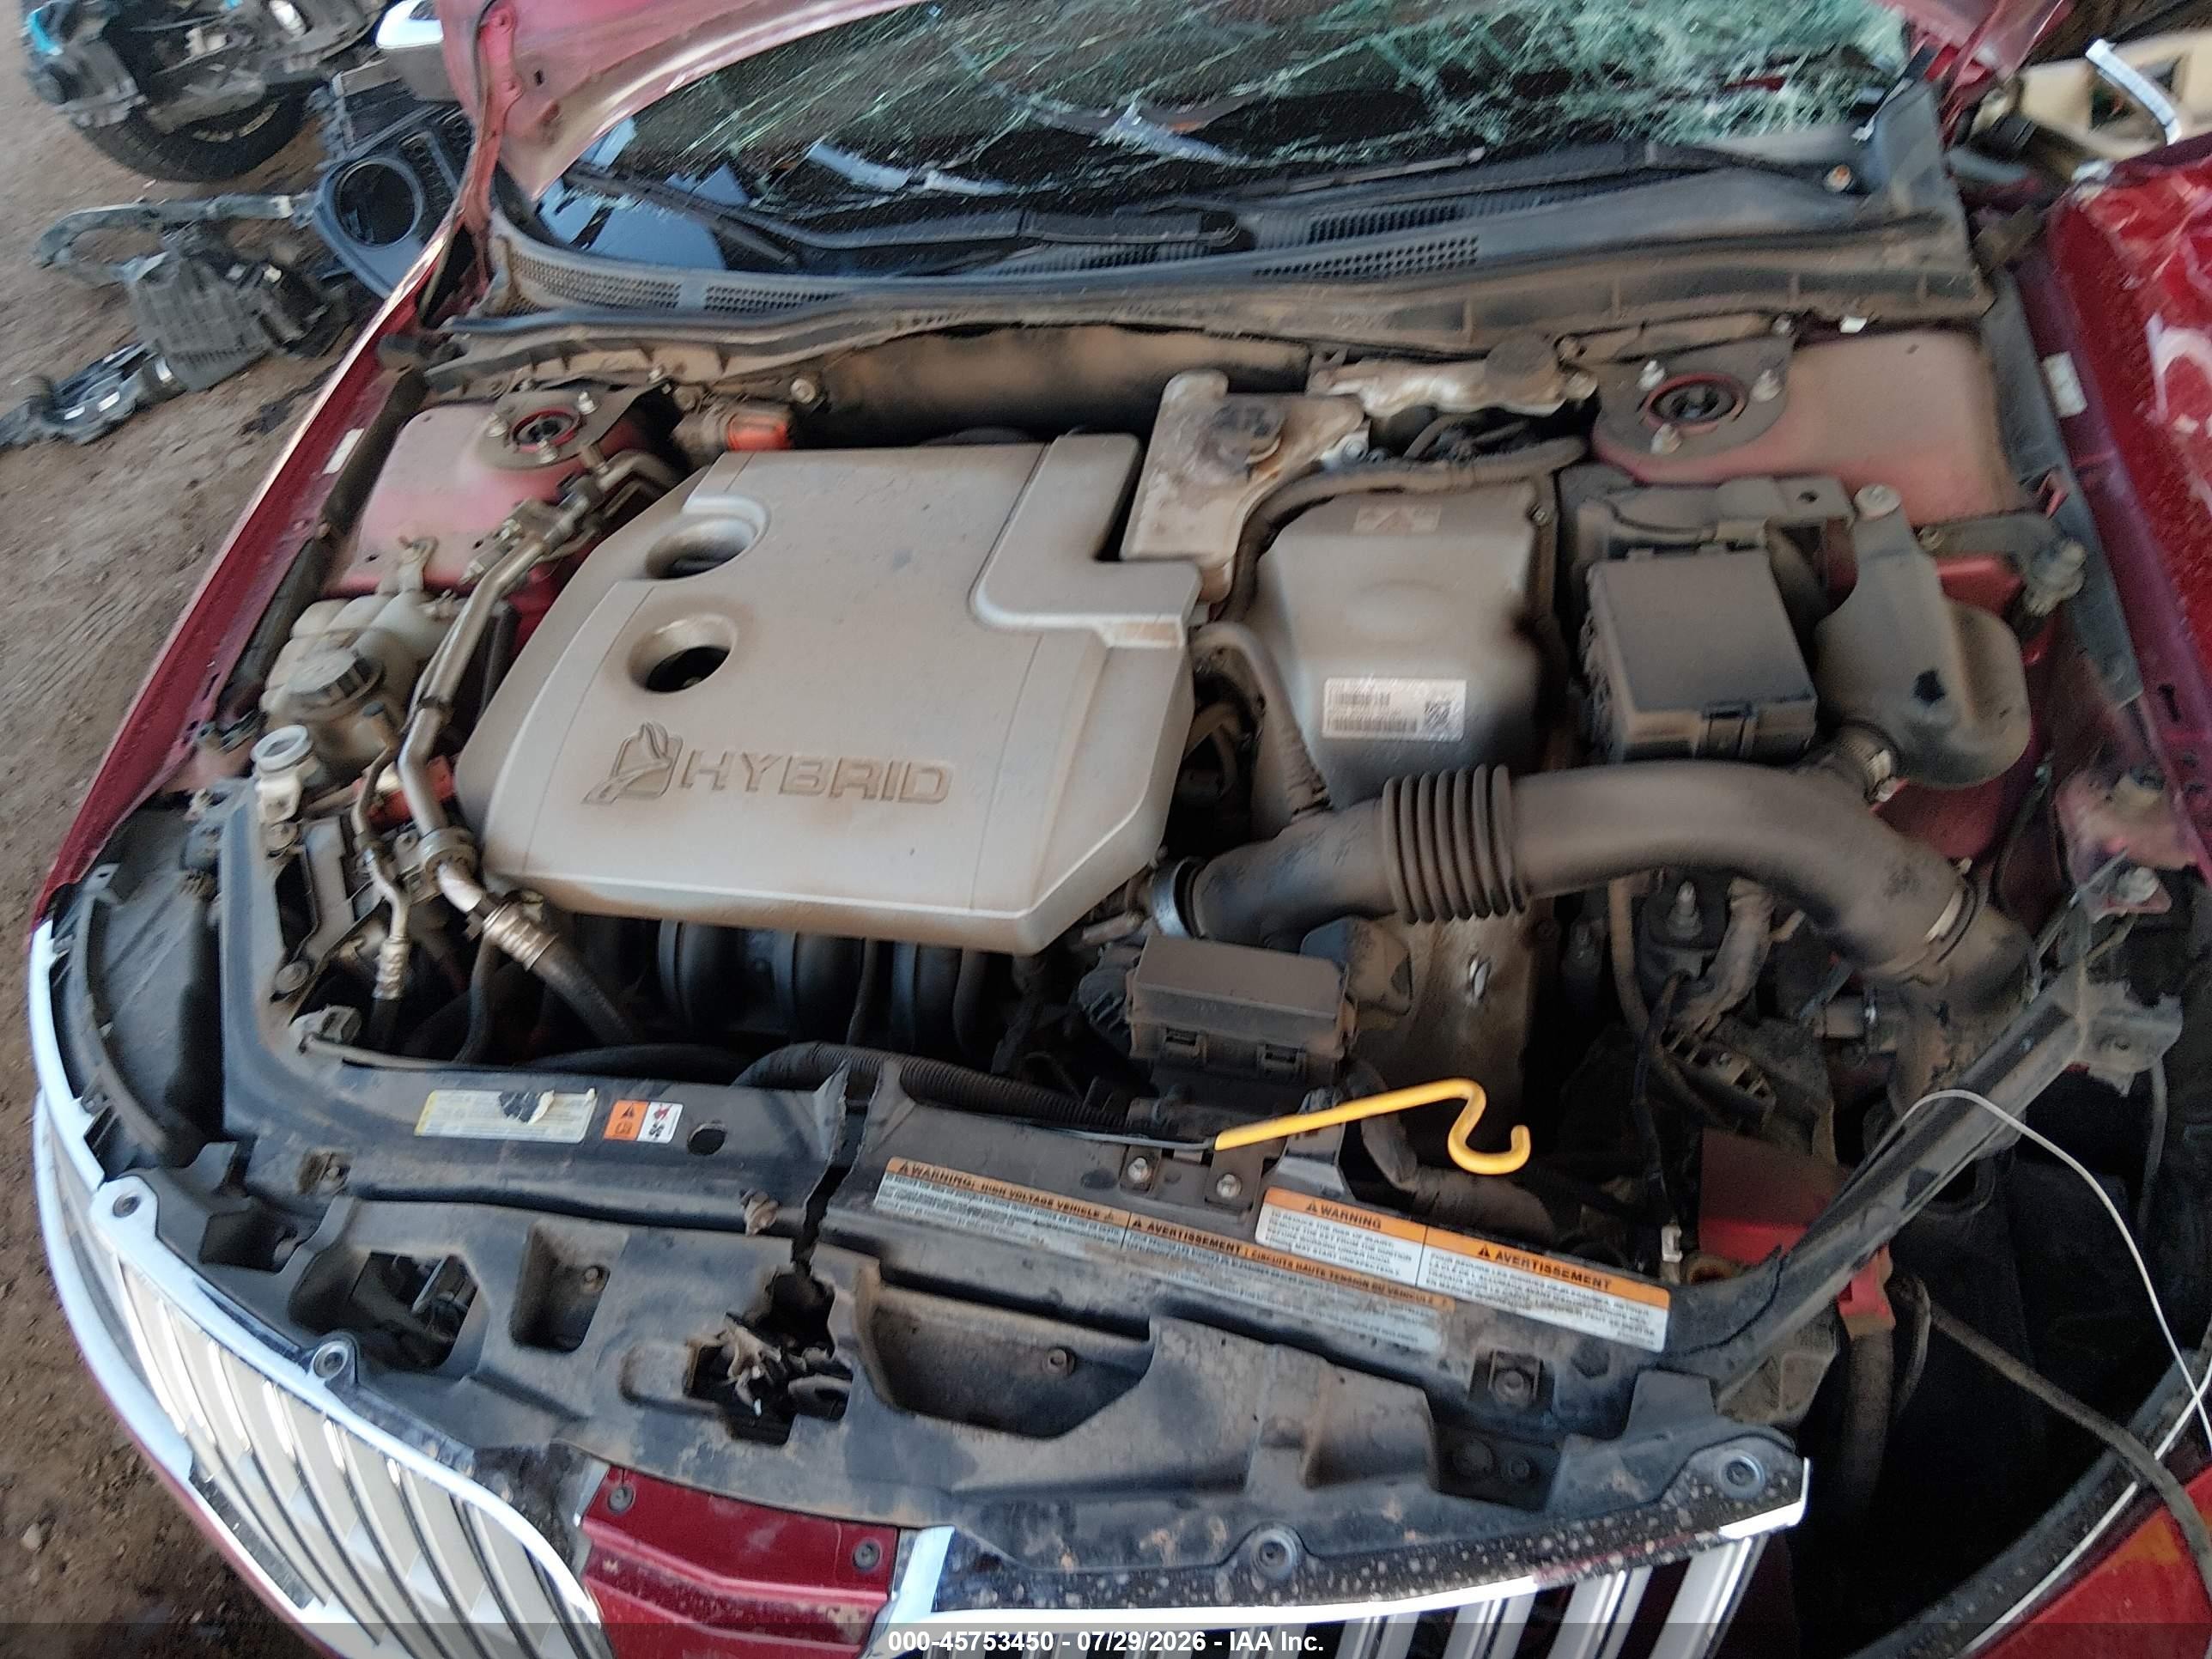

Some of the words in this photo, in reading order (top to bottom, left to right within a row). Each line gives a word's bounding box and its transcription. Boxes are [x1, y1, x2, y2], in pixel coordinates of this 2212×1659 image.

[681, 749, 955, 804] HYBRID
[1007, 1188, 1054, 1207] VOLTAGE
[1055, 1199, 1102, 1218] VEHICLE
[1319, 1203, 1382, 1230] WARNING
[1146, 1219, 1242, 1255] AVERTISSEMENT
[1328, 1268, 1370, 1289] TENSION
[1494, 1249, 1612, 1291] AVERTISSEMENT
